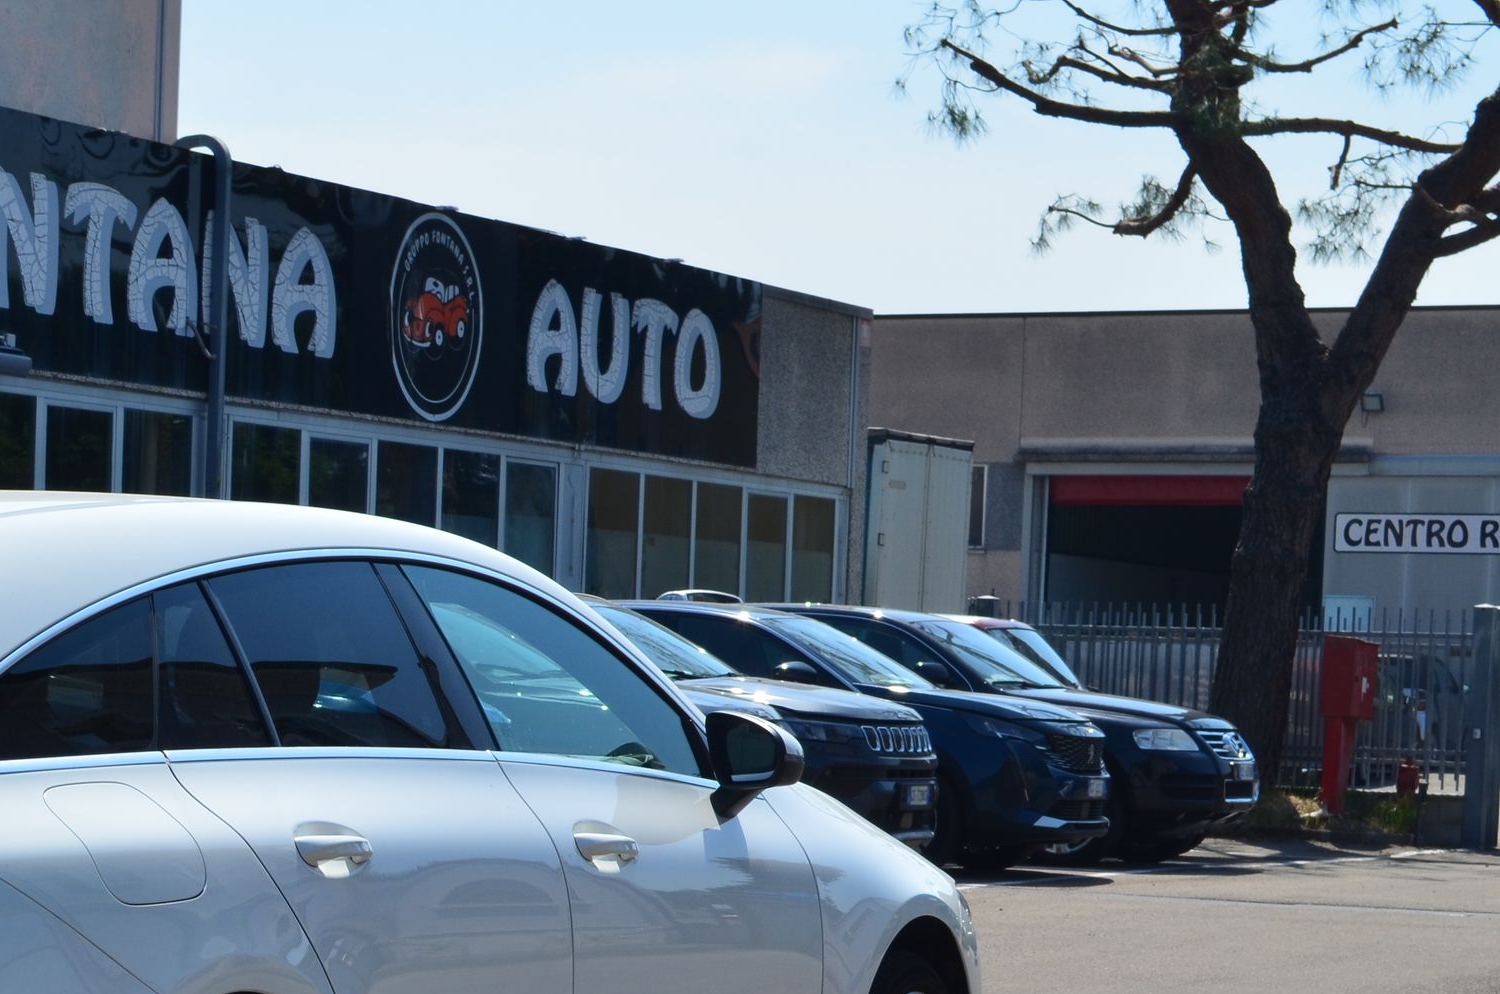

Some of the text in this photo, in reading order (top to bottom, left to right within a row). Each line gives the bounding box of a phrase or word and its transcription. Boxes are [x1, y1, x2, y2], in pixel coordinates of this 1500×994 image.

[404, 232, 430, 272] GRUPPO
[431, 229, 464, 266] FONTANA
[526, 278, 721, 419] AUTO
[1343, 518, 1500, 549] CENTRO R
